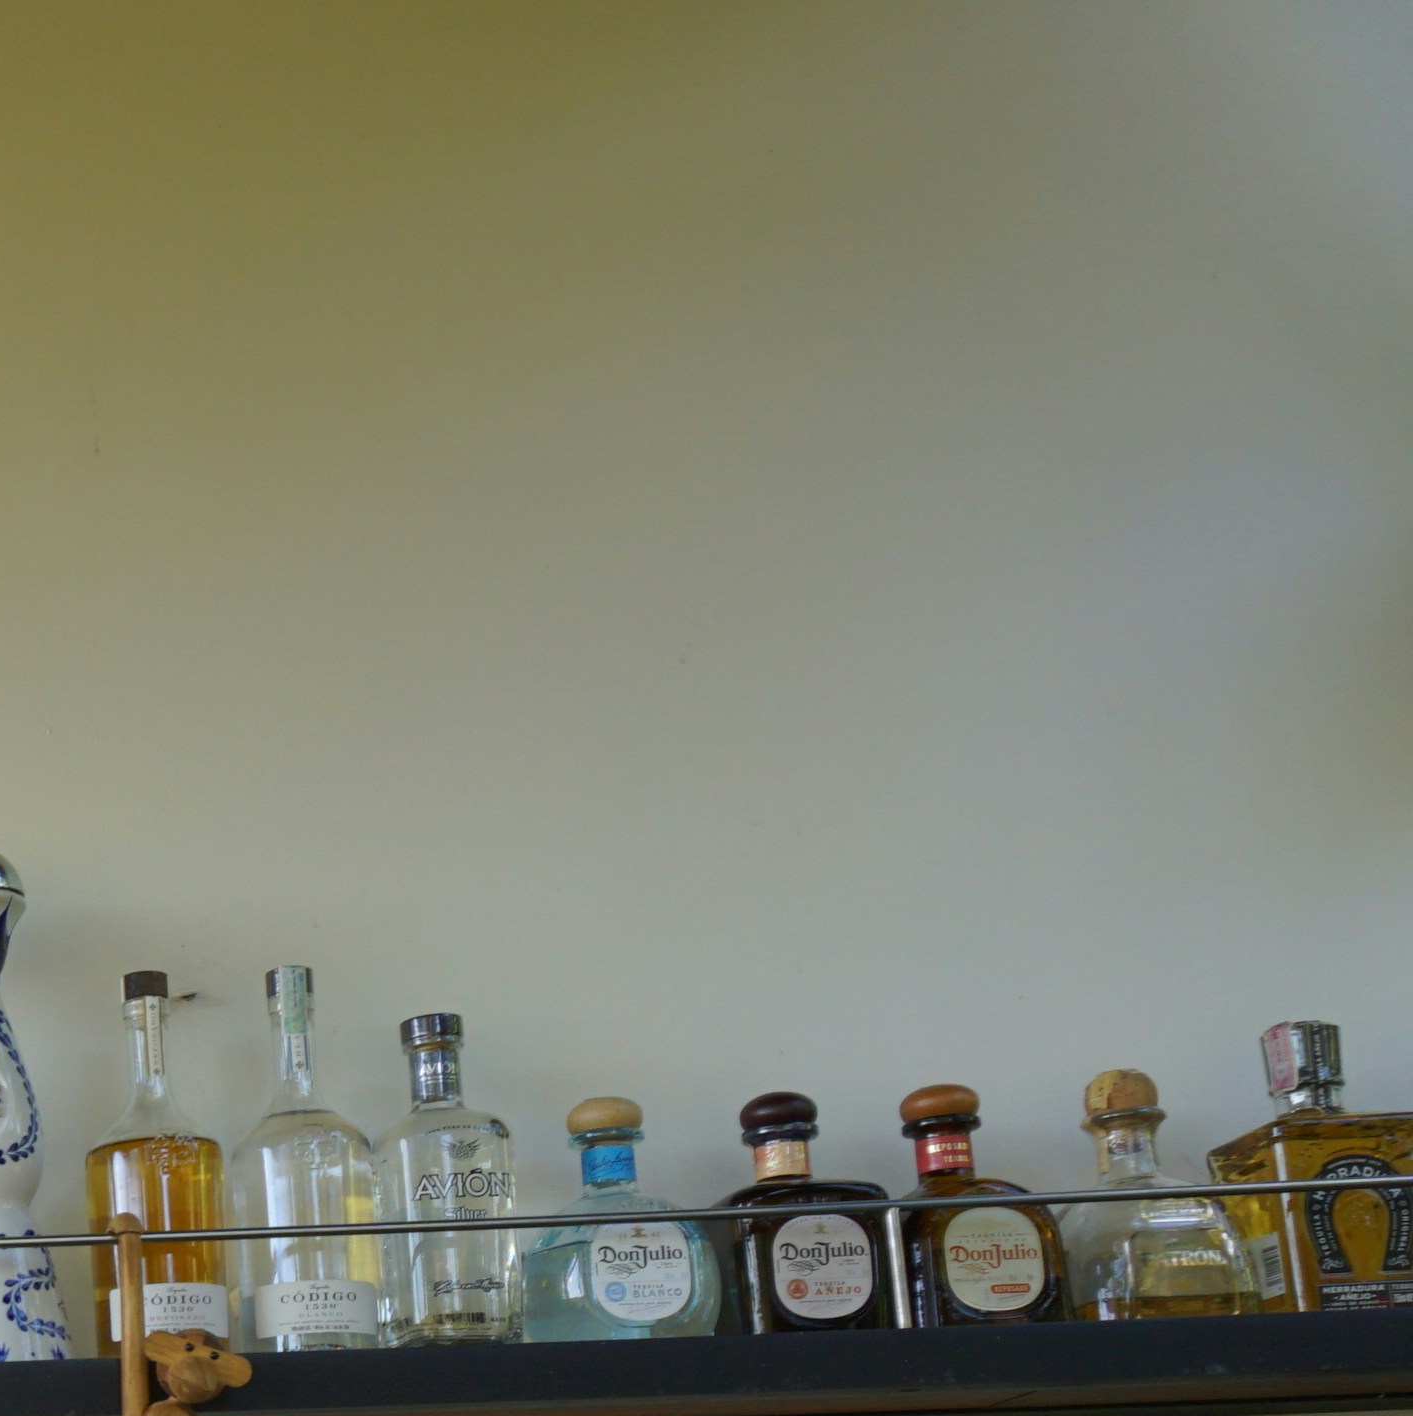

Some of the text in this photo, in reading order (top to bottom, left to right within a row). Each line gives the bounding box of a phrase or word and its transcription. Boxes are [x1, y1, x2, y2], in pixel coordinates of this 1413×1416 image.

[413, 1168, 510, 1201] AVIÓN
[280, 1289, 358, 1306] CÓDIGO
[815, 1282, 862, 1296] AÑEJO
